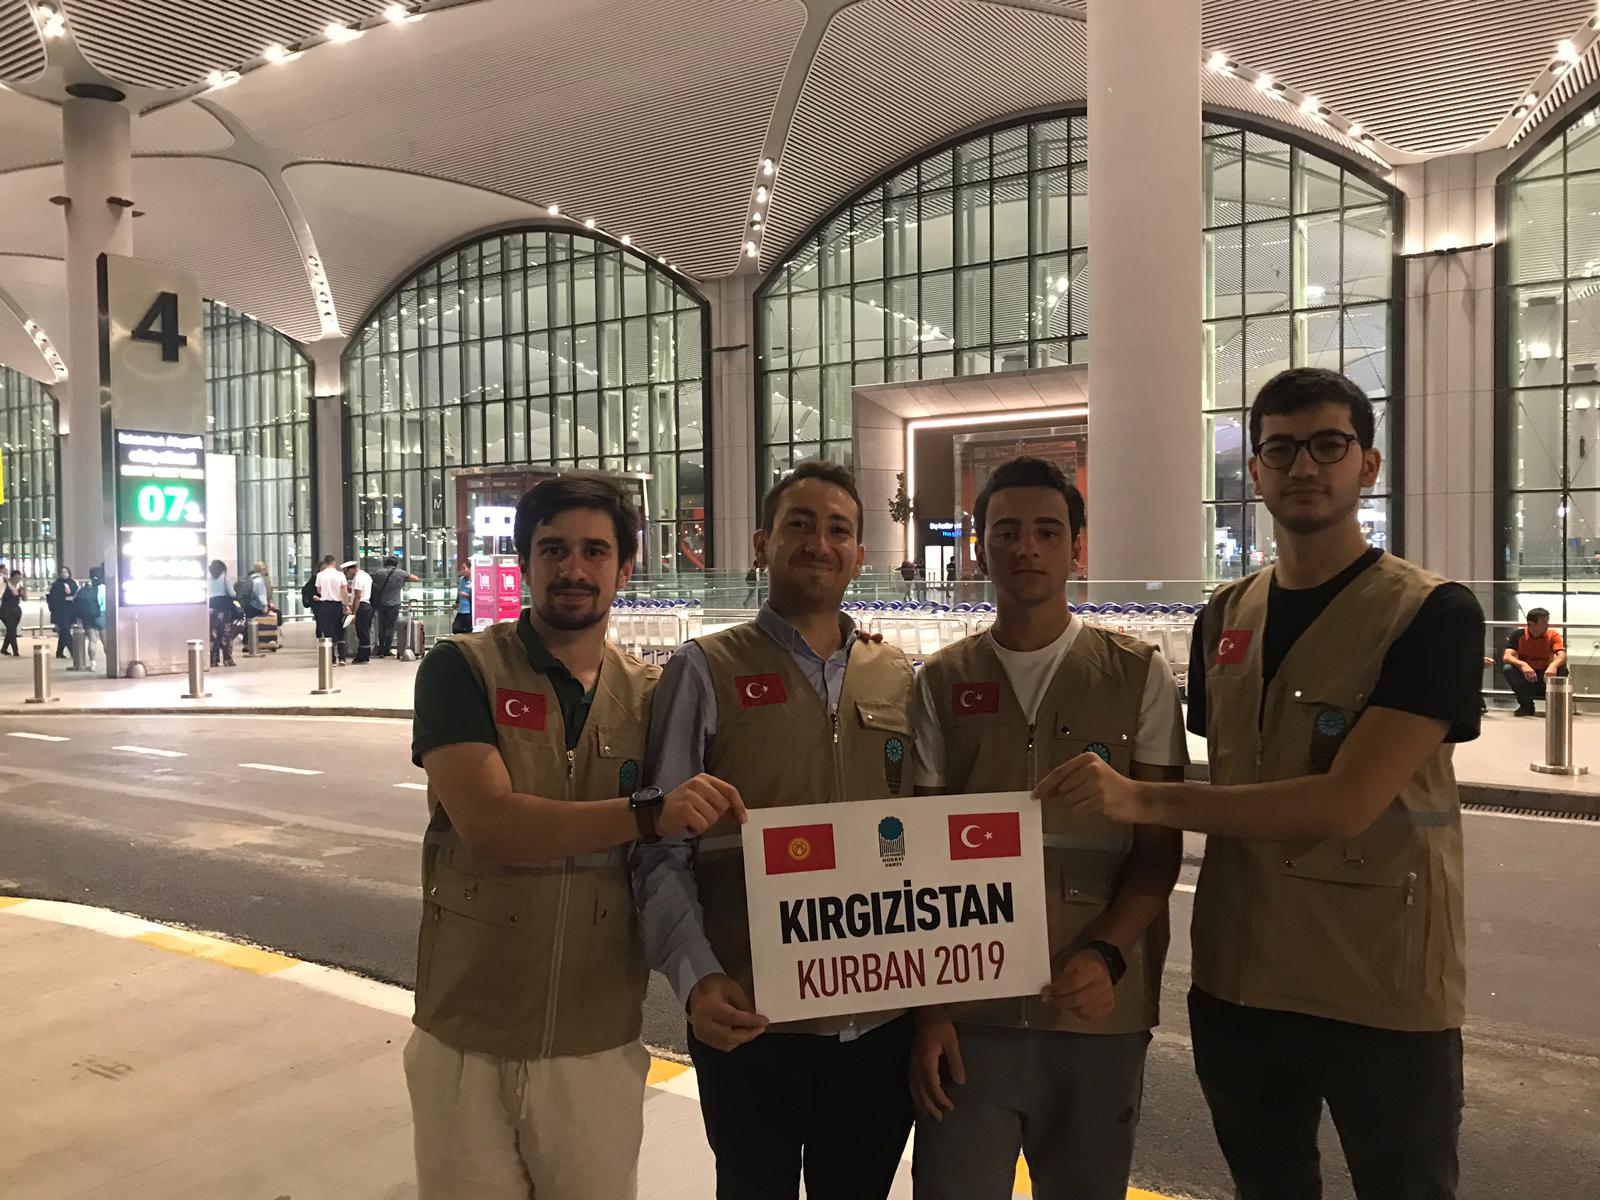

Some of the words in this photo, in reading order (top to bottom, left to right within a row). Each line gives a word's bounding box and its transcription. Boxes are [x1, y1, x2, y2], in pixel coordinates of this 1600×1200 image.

[131, 291, 187, 362] 4
[779, 880, 1014, 944] KIRGIZİSTAN
[797, 948, 926, 1000] KURBAN
[934, 941, 1004, 985] 2019
